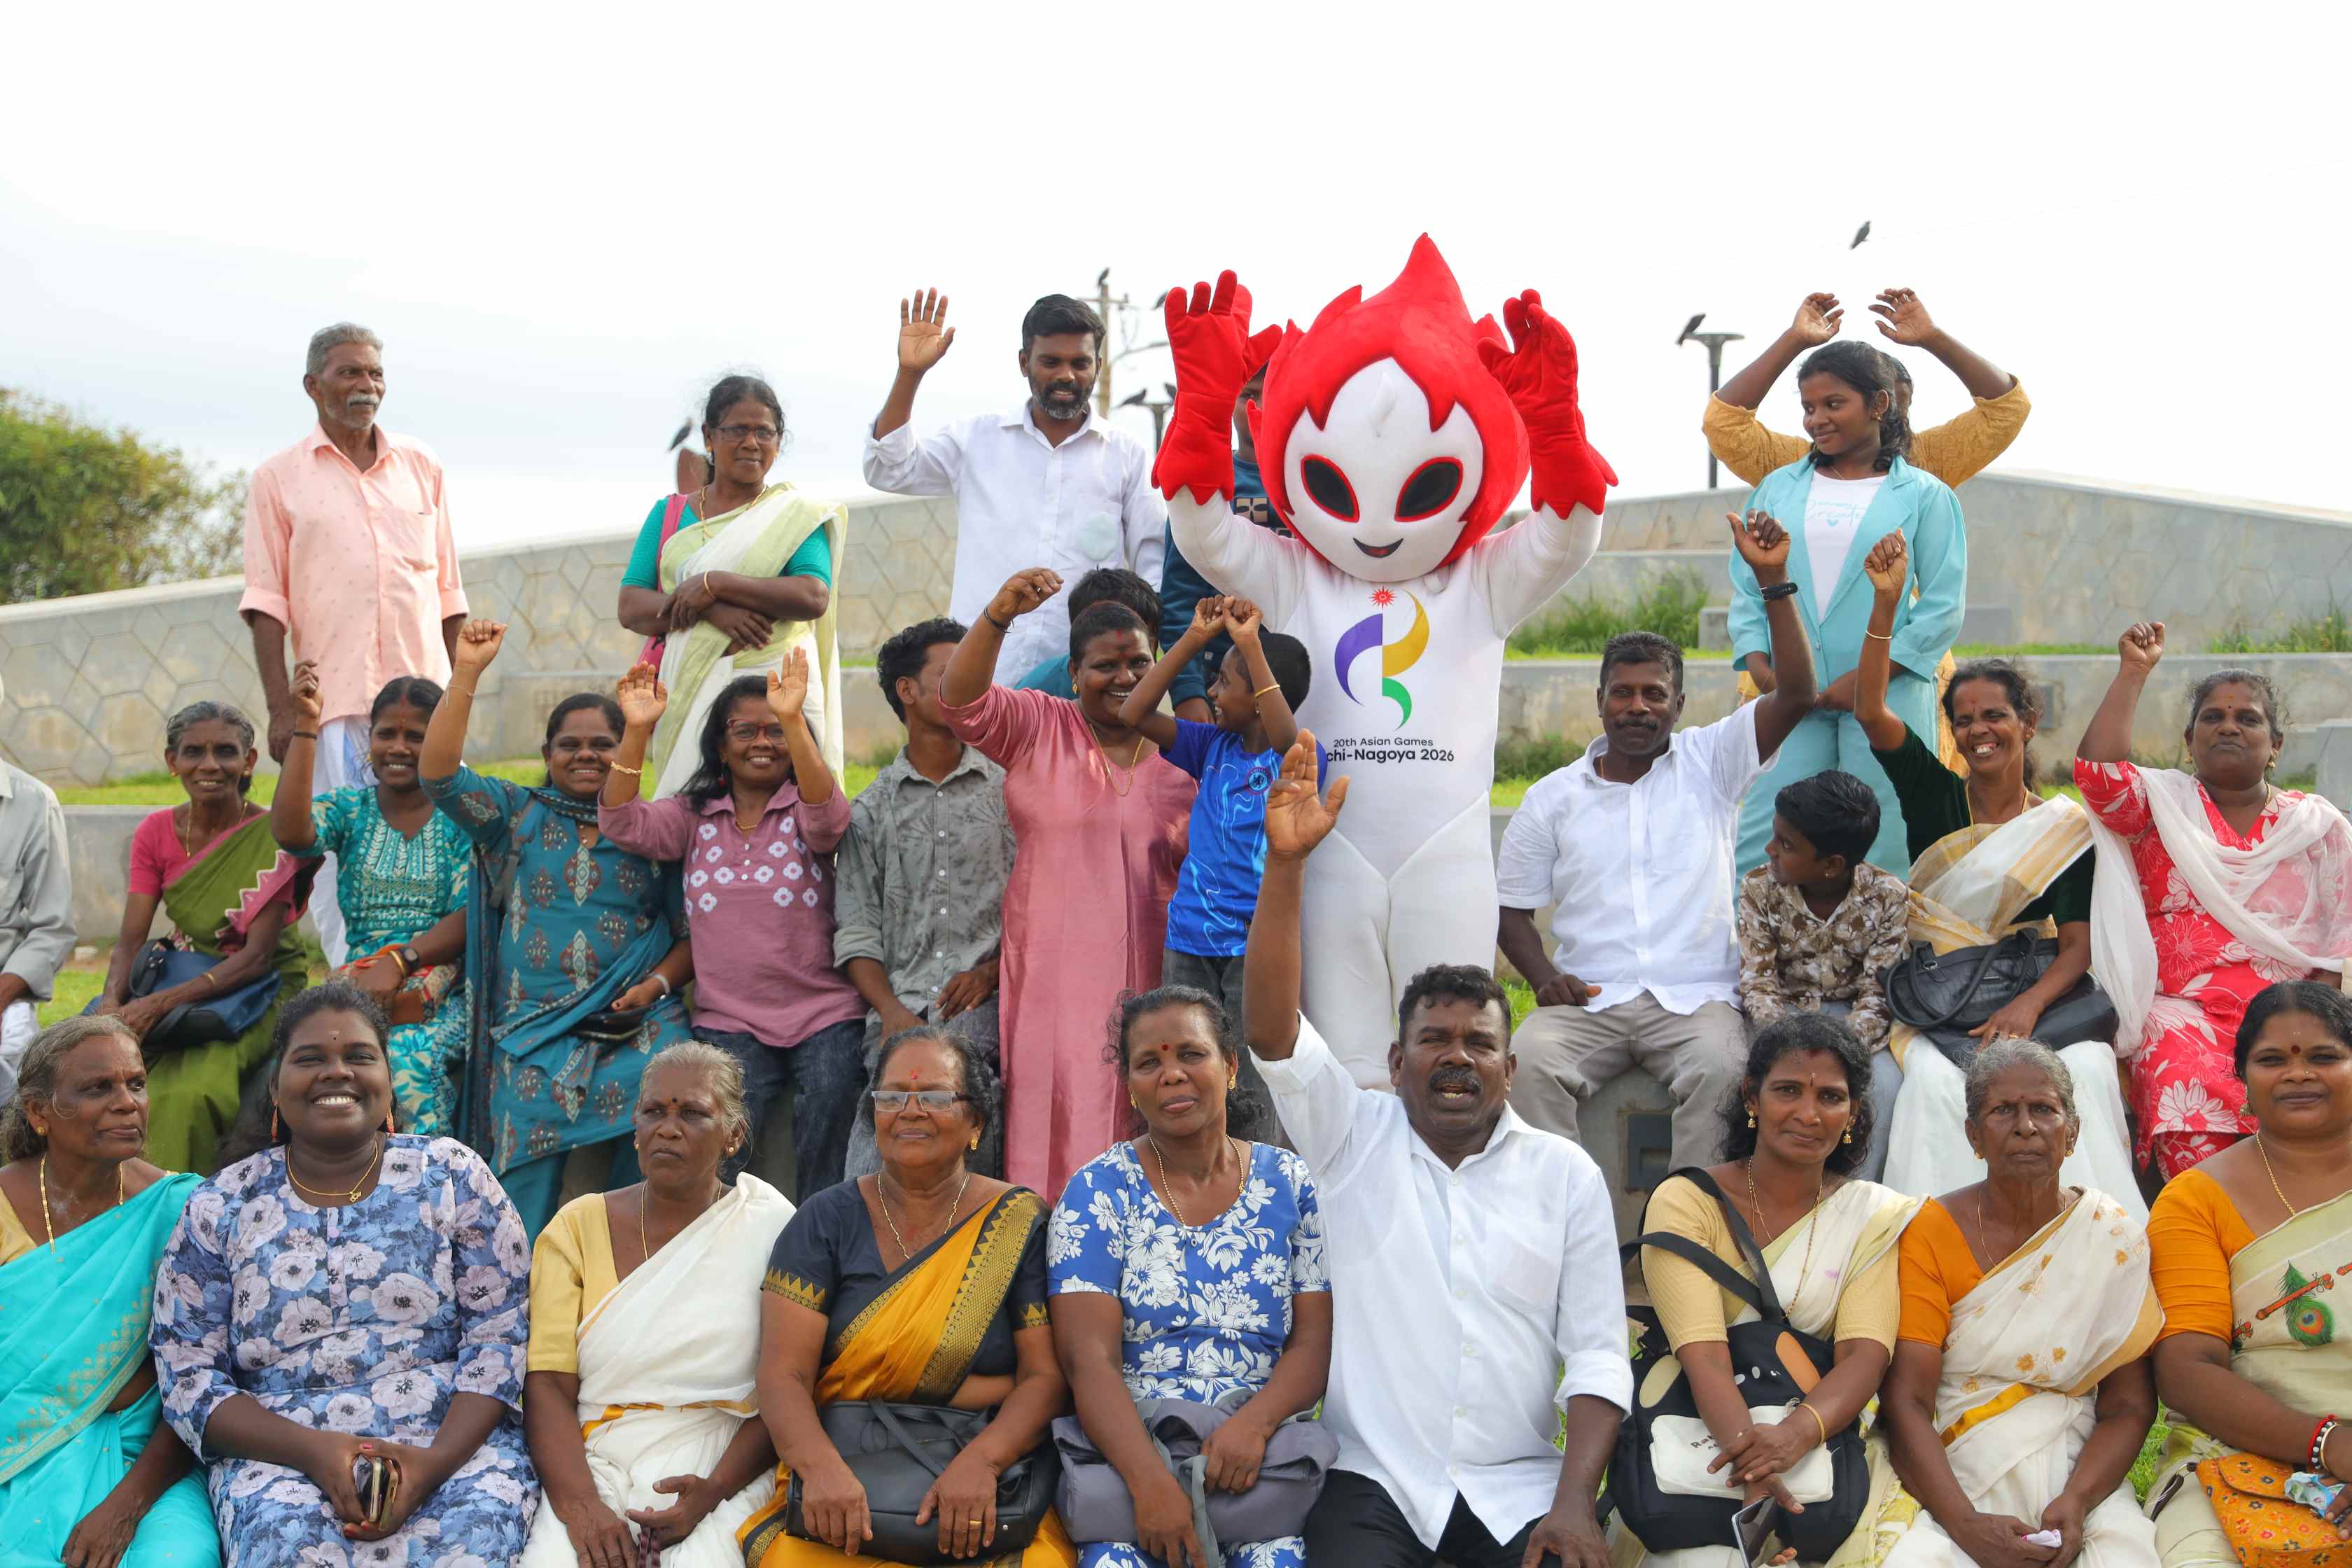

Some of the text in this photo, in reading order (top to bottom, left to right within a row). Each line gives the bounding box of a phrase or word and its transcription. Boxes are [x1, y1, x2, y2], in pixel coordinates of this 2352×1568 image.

[1334, 736, 1434, 748] 20th Asian Games
[1326, 748, 1455, 764] chi-Nagoya 2026
